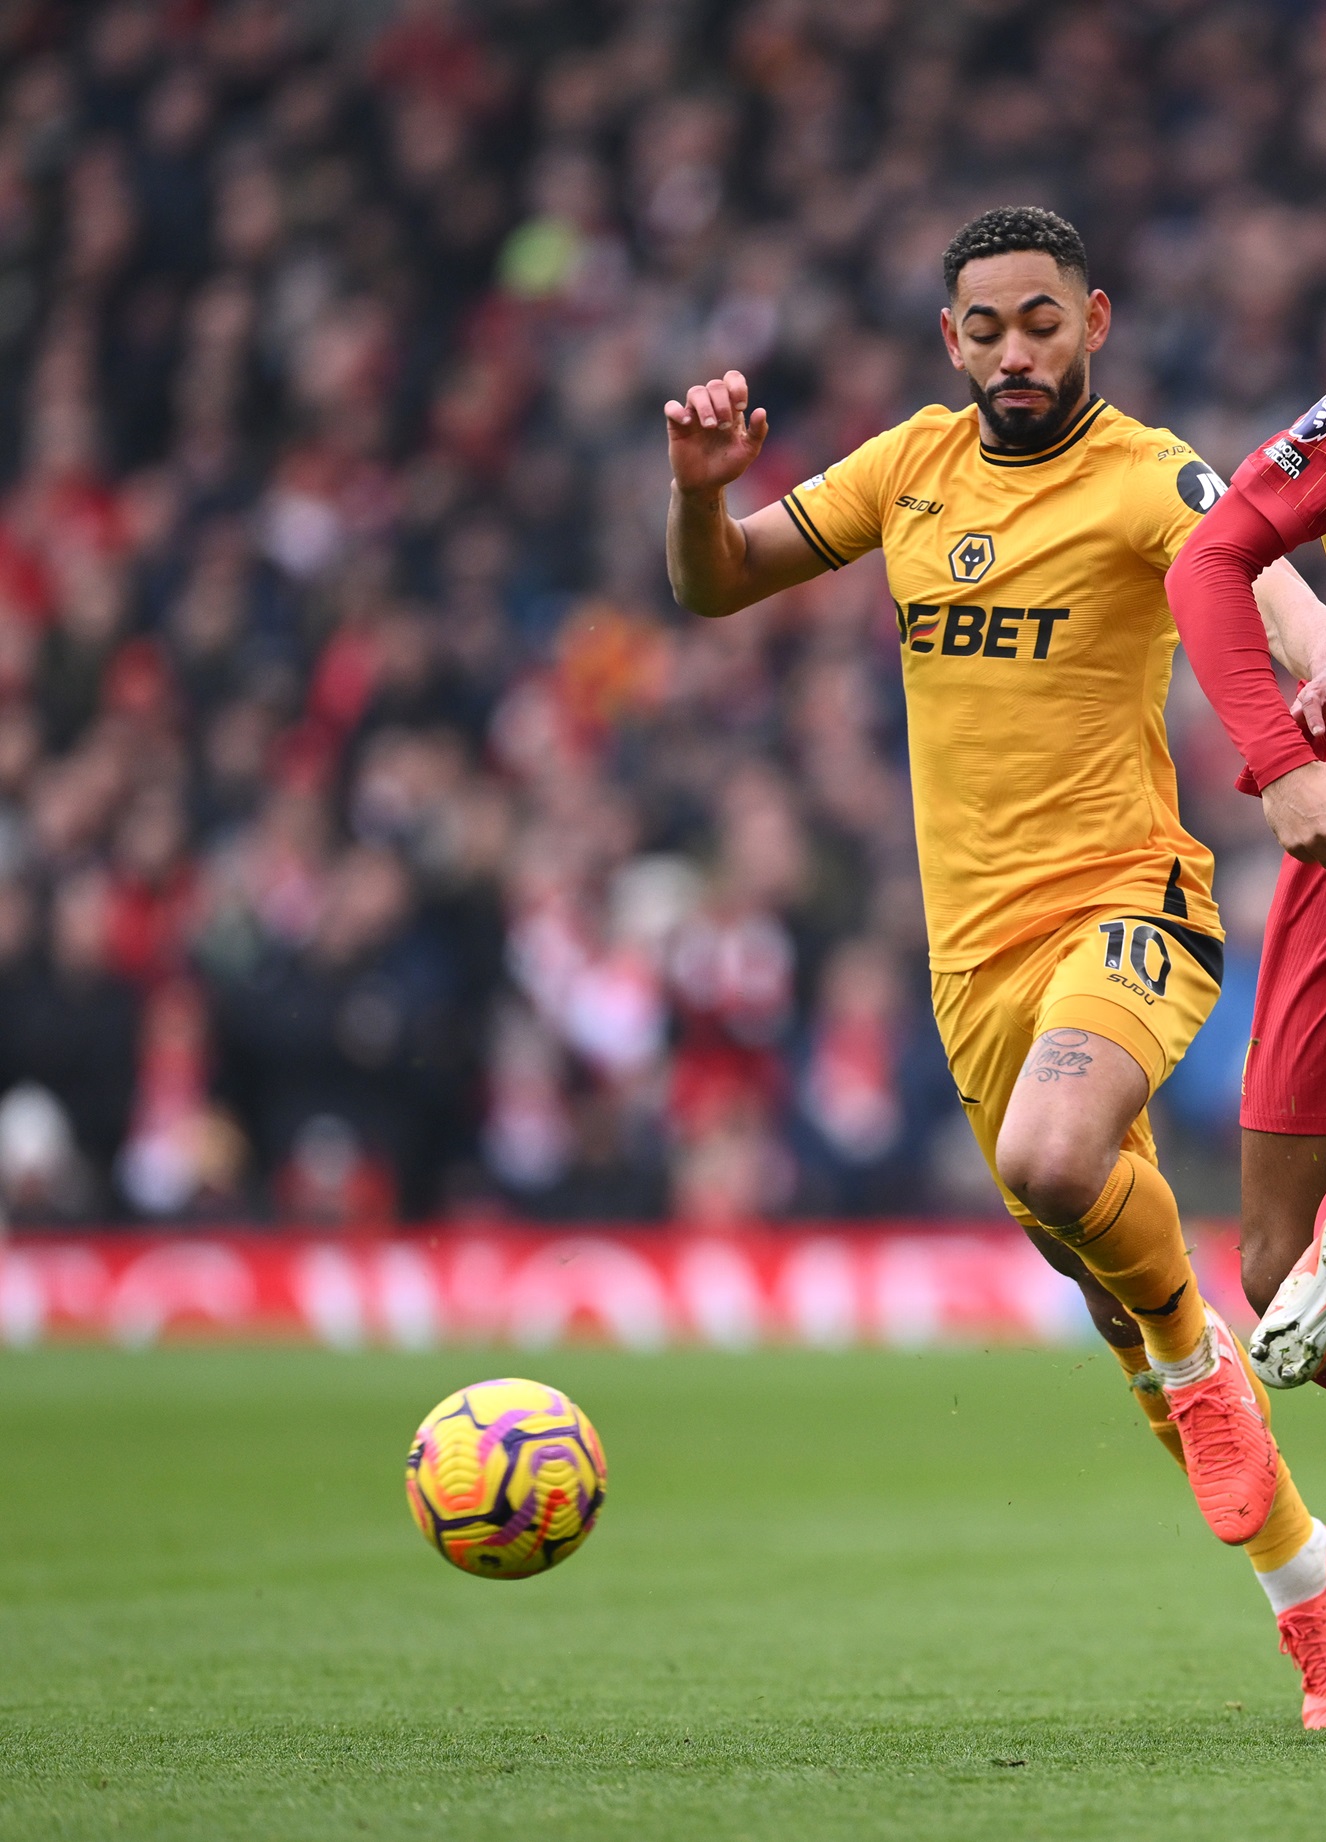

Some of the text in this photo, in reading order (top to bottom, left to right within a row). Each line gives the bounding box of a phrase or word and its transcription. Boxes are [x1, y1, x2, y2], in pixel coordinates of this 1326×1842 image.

[895, 495, 944, 515] SUDU
[1098, 920, 1172, 998] 10
[1106, 973, 1155, 1006] SUDU
